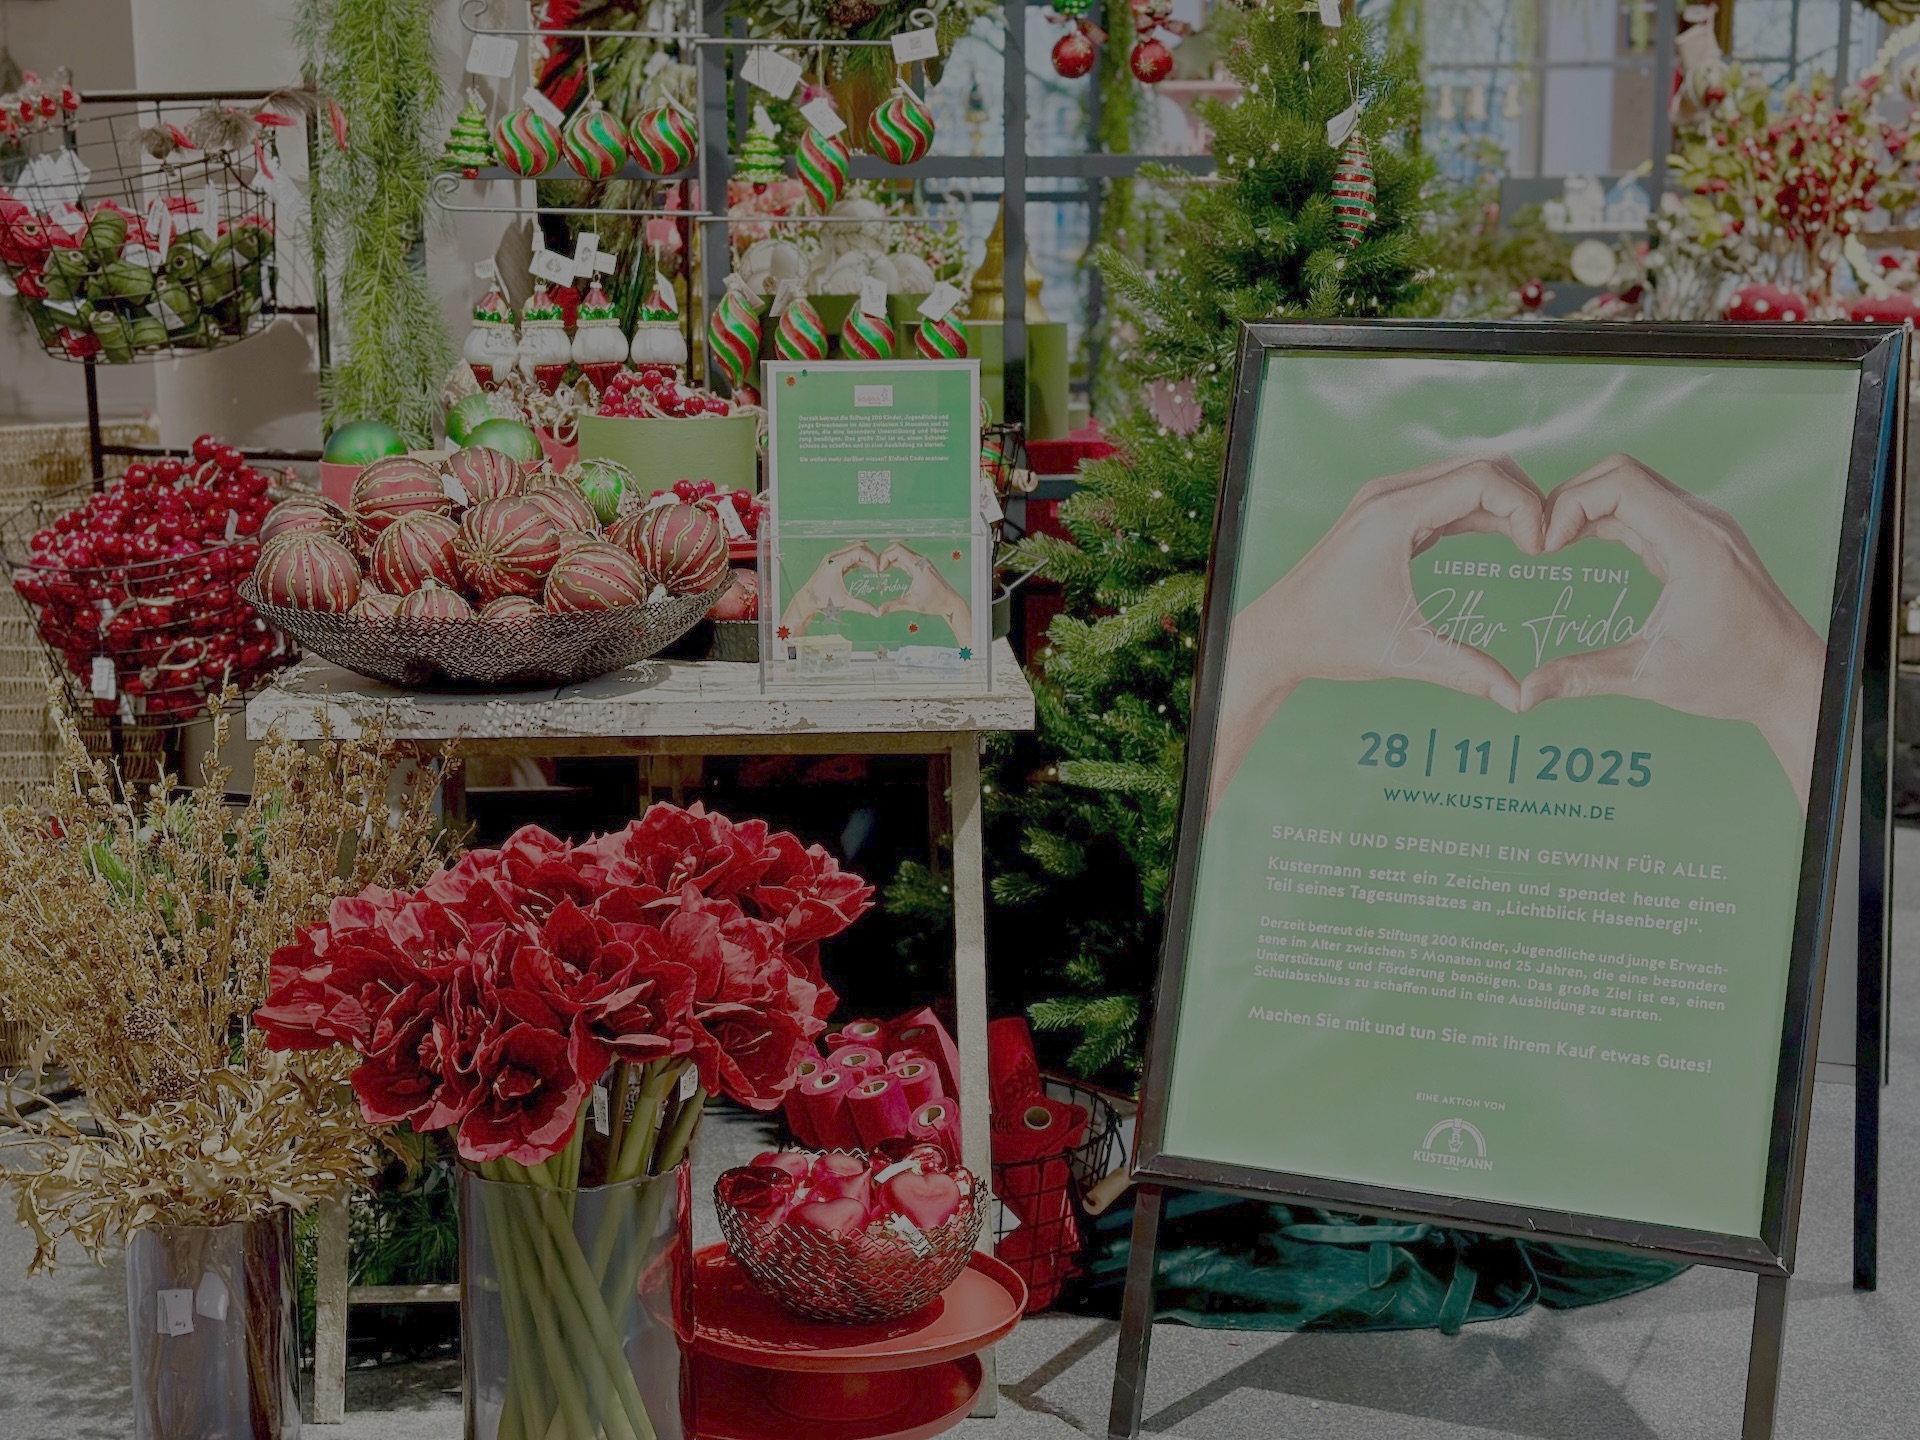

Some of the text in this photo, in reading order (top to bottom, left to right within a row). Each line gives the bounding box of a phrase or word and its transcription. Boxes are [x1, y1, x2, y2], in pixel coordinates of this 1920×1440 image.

[1434, 560, 1630, 585] LIEBER GUTES TUN!
[1358, 732, 1409, 768] 28
[1454, 739, 1491, 775] 11
[1536, 745, 1652, 788] 2025
[1384, 788, 1615, 820] WWW.KUSTERMANN.DE
[1271, 824, 1728, 880] SPAREN UND SPENDEN! EIN GEWINN FÜR ALLE.
[1266, 876, 1292, 892] Teil
[1296, 880, 1345, 898] seines
[1350, 884, 1468, 910] Tagesumsatzes
[1472, 900, 1492, 912] an
[1268, 856, 1736, 915] Kustermann setzt ein Zeichen und spendet heute einen
[1258, 933, 1728, 994] sene im Alter zwischen 5 Monaten und 25 Jahren, die eine besondere
[1260, 916, 1728, 976] Derzeit betreut die Stiftung 200 Kinder, Jugendliche und junge Erwach-
[1254, 964, 1662, 1022] Schulabschluss zu schaffen und in eine Ausbildung zu starten.
[1256, 948, 1726, 1011] Unterstützung und Förderung benötigen. Das große Ziel ist es, einen
[1248, 1005, 1712, 1074] Machen Sie mit und tun Sie mit Ihrem Kauf etwas Gutes!
[1416, 1092, 1506, 1111] EINE AKTION VON
[1413, 1150, 1494, 1171] KUSTERMANN
